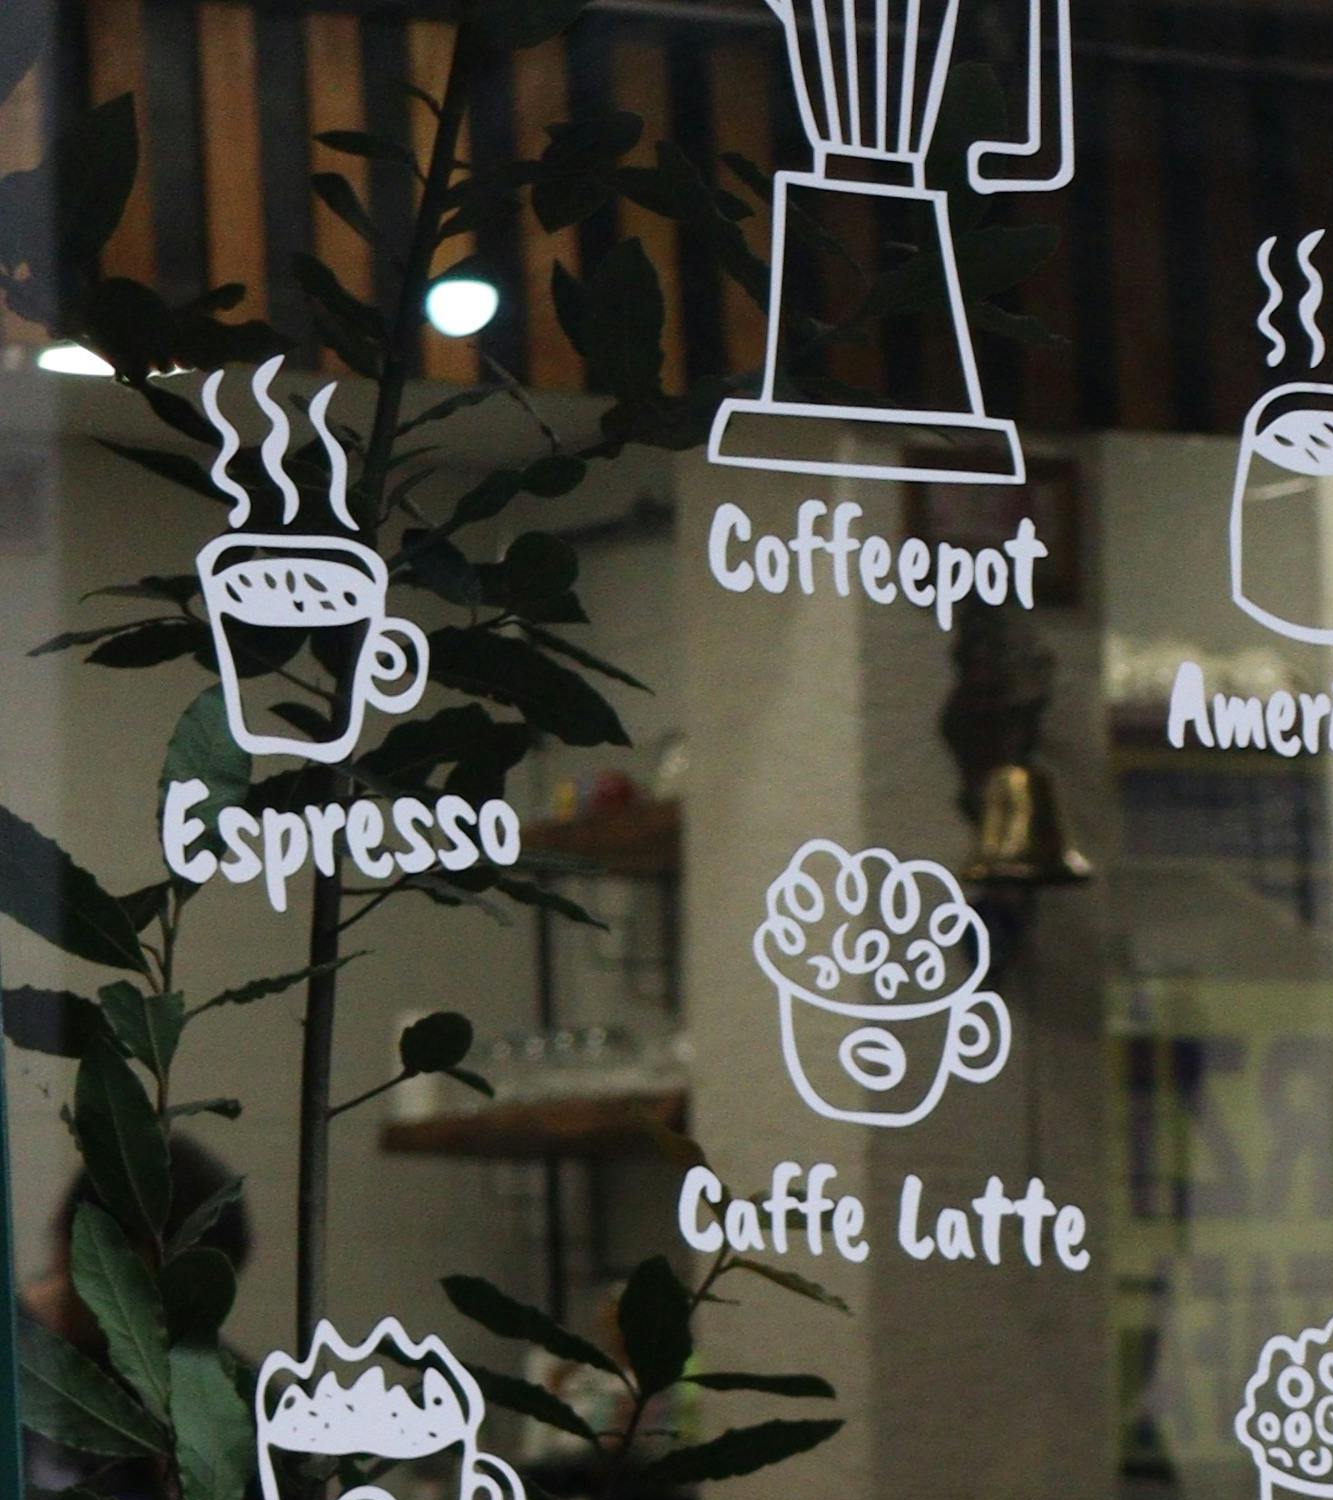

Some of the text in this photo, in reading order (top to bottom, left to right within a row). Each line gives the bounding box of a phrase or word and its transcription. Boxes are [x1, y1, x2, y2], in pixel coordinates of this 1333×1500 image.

[708, 499, 1047, 630] Coffeepot
[163, 778, 520, 912] Espresso
[679, 1161, 1090, 1271] Caffe Latte
